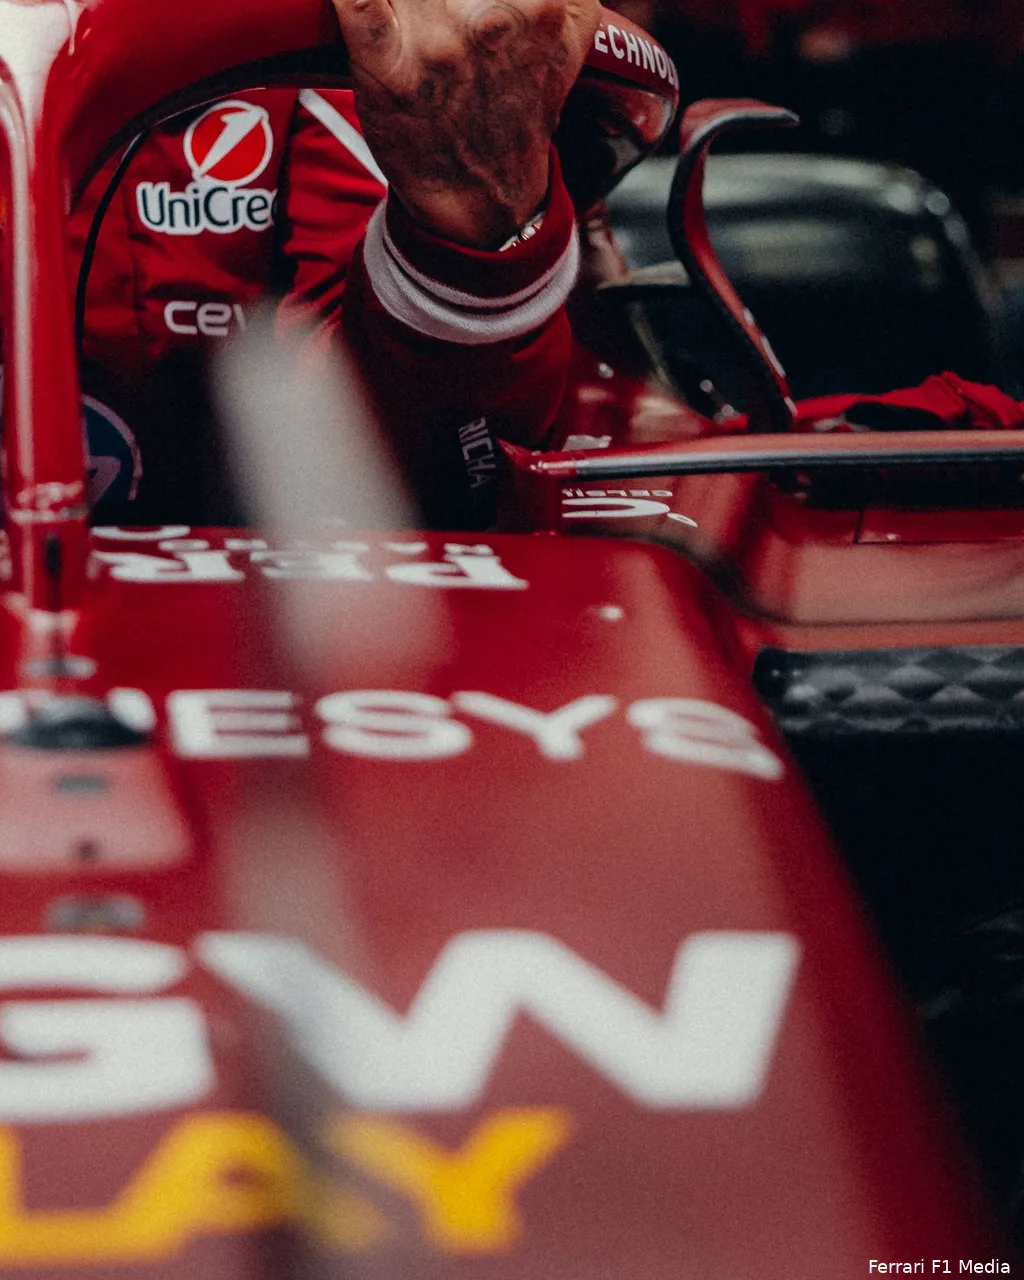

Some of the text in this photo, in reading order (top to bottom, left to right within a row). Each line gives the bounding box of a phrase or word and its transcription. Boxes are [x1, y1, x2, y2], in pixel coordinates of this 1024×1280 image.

[594, 23, 680, 91] ECHNOL
[140, 185, 278, 229] UniCre
[458, 417, 498, 489] RICHA
